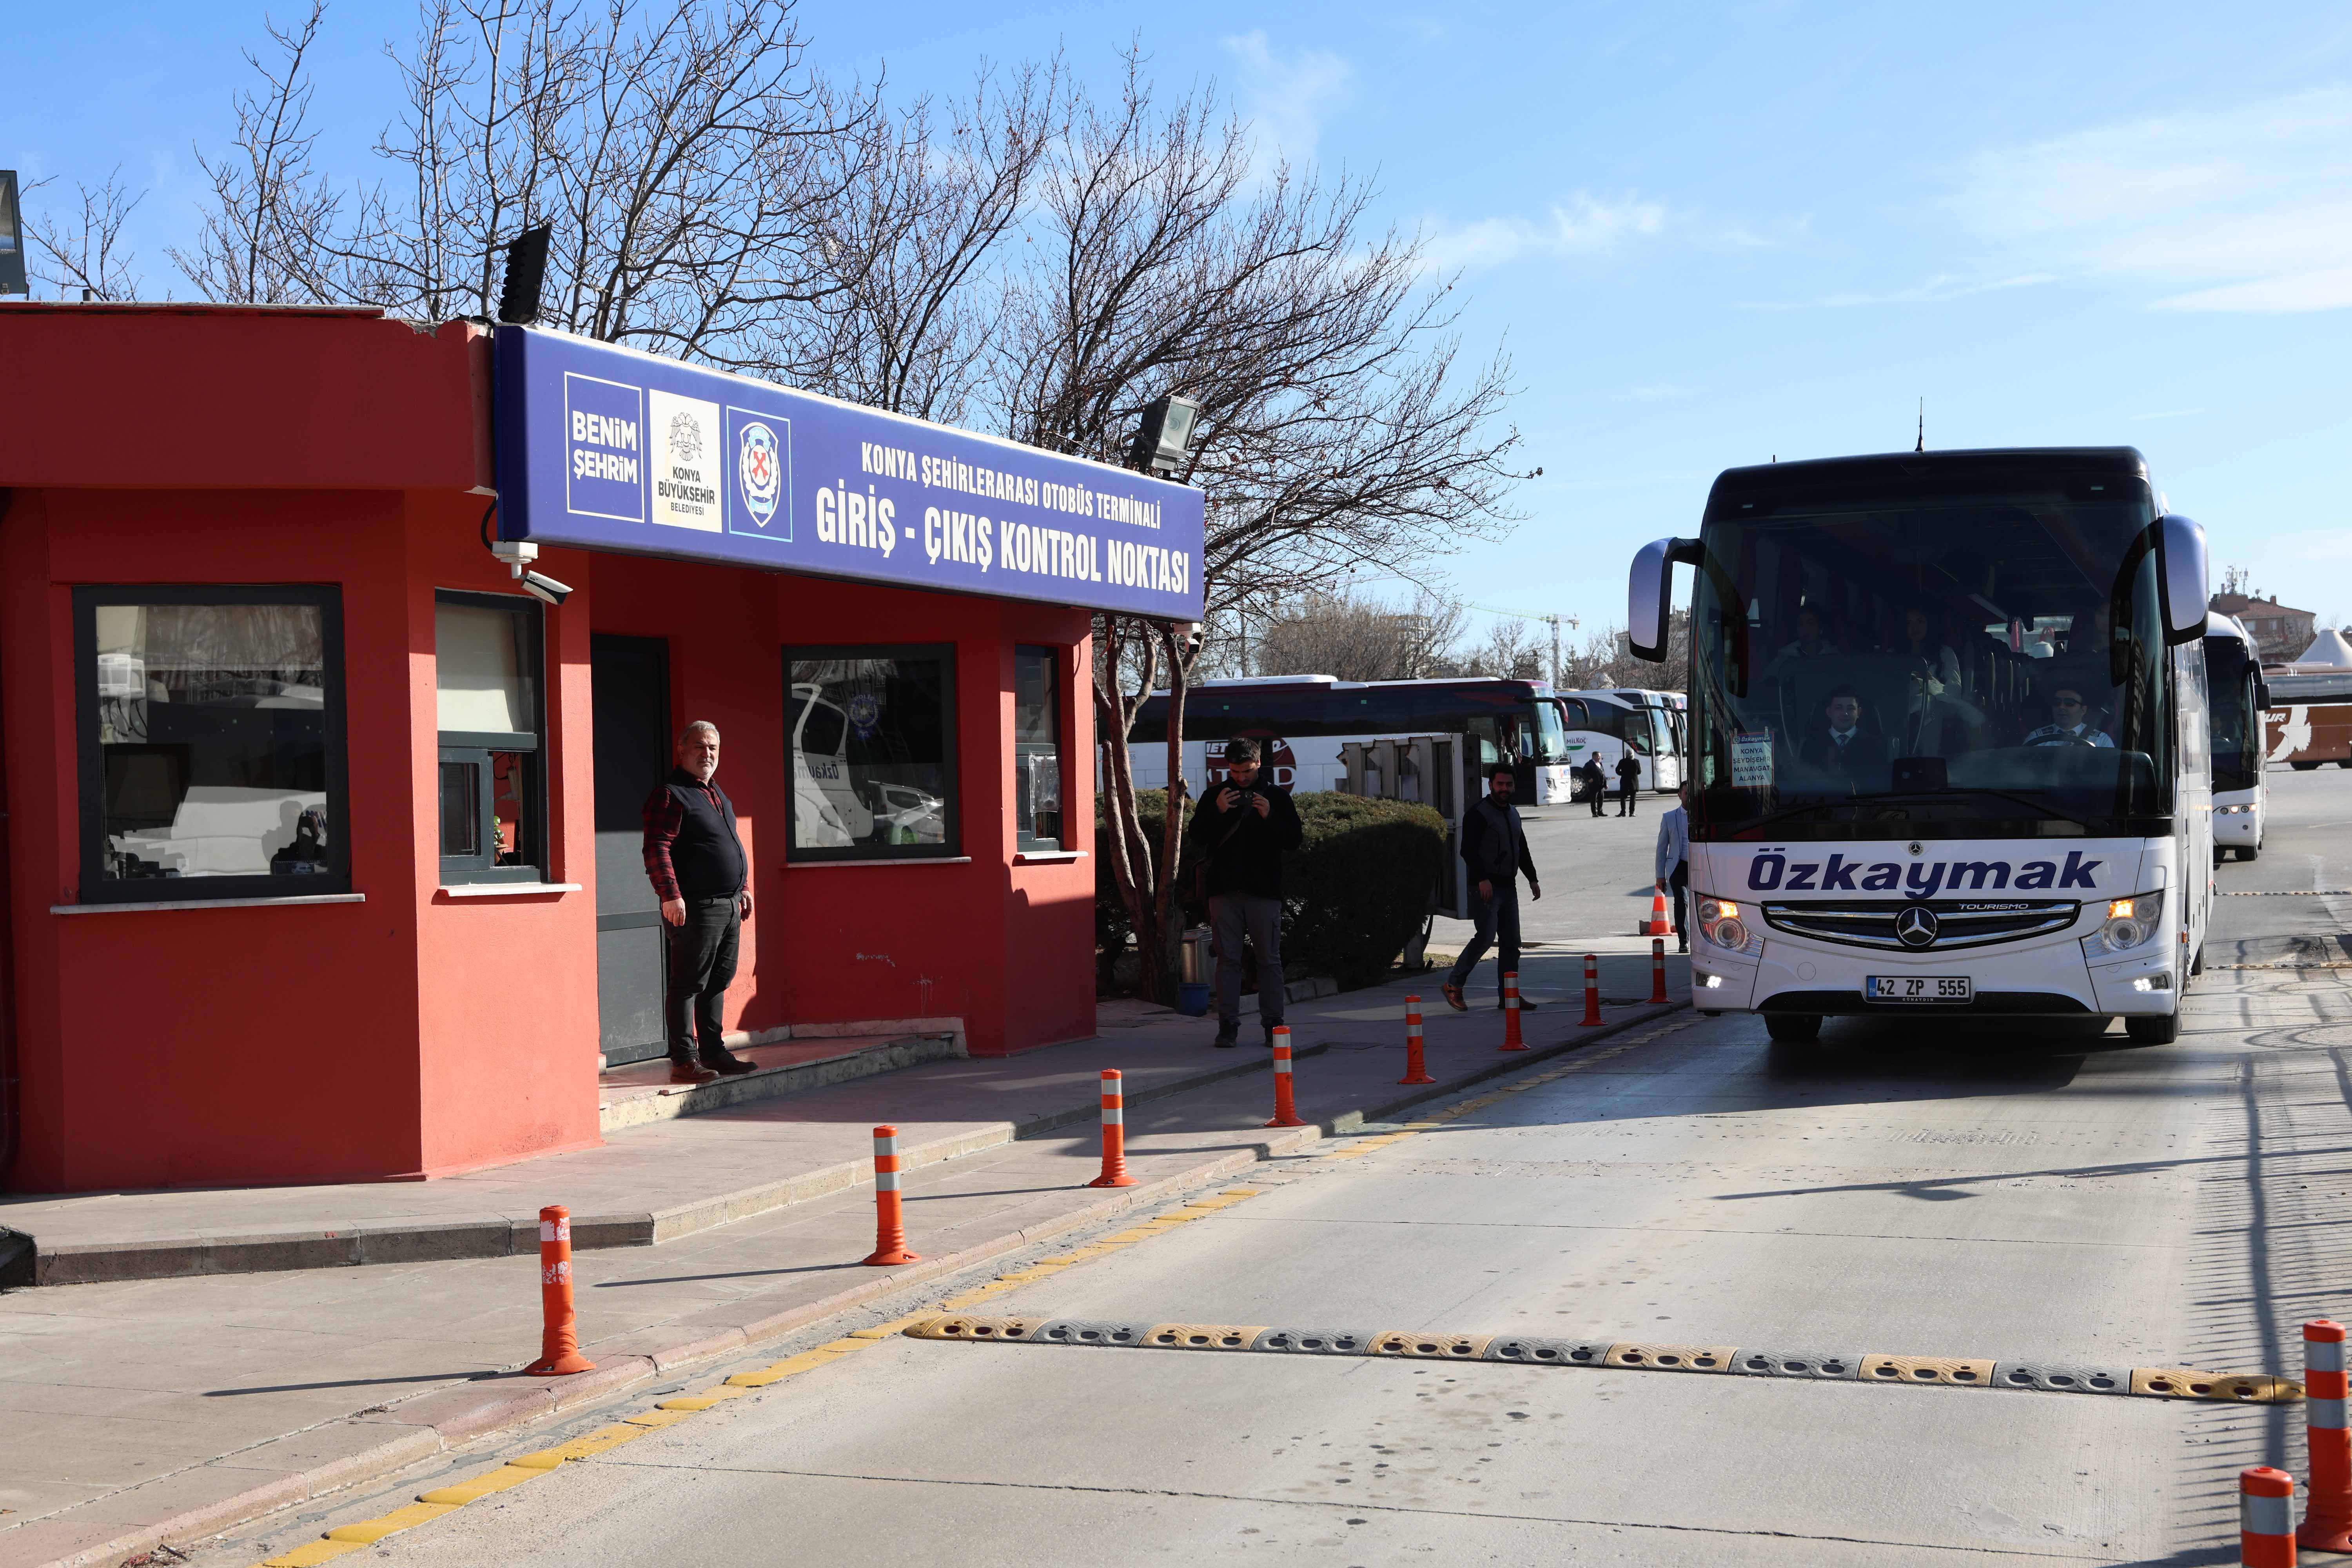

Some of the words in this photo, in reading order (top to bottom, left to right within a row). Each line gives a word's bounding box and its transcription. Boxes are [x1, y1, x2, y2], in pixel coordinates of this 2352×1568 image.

[673, 466, 701, 483] KONYA
[658, 480, 715, 505] BÜYÜKŞEHİR
[862, 442, 917, 482] KONYA
[922, 456, 1038, 506] ŞEHİRLERARASI
[1043, 483, 1093, 517] OTOBÜS
[1096, 493, 1161, 529] TERMİNALİ
[671, 501, 704, 516] BELEDİYESİ
[816, 479, 895, 558] GİRİŞ
[905, 527, 915, 539] -
[924, 506, 993, 572] ÇIKIŞ
[1001, 521, 1101, 582] KONTROL
[1108, 539, 1189, 595] NOKTASI
[1733, 755, 1771, 764] SEYDİŞEHİR
[1748, 848, 2105, 900] Özkaymak
[1877, 979, 1895, 995] 42
[1906, 980, 1924, 995] ZP
[1938, 980, 1966, 996] 555
